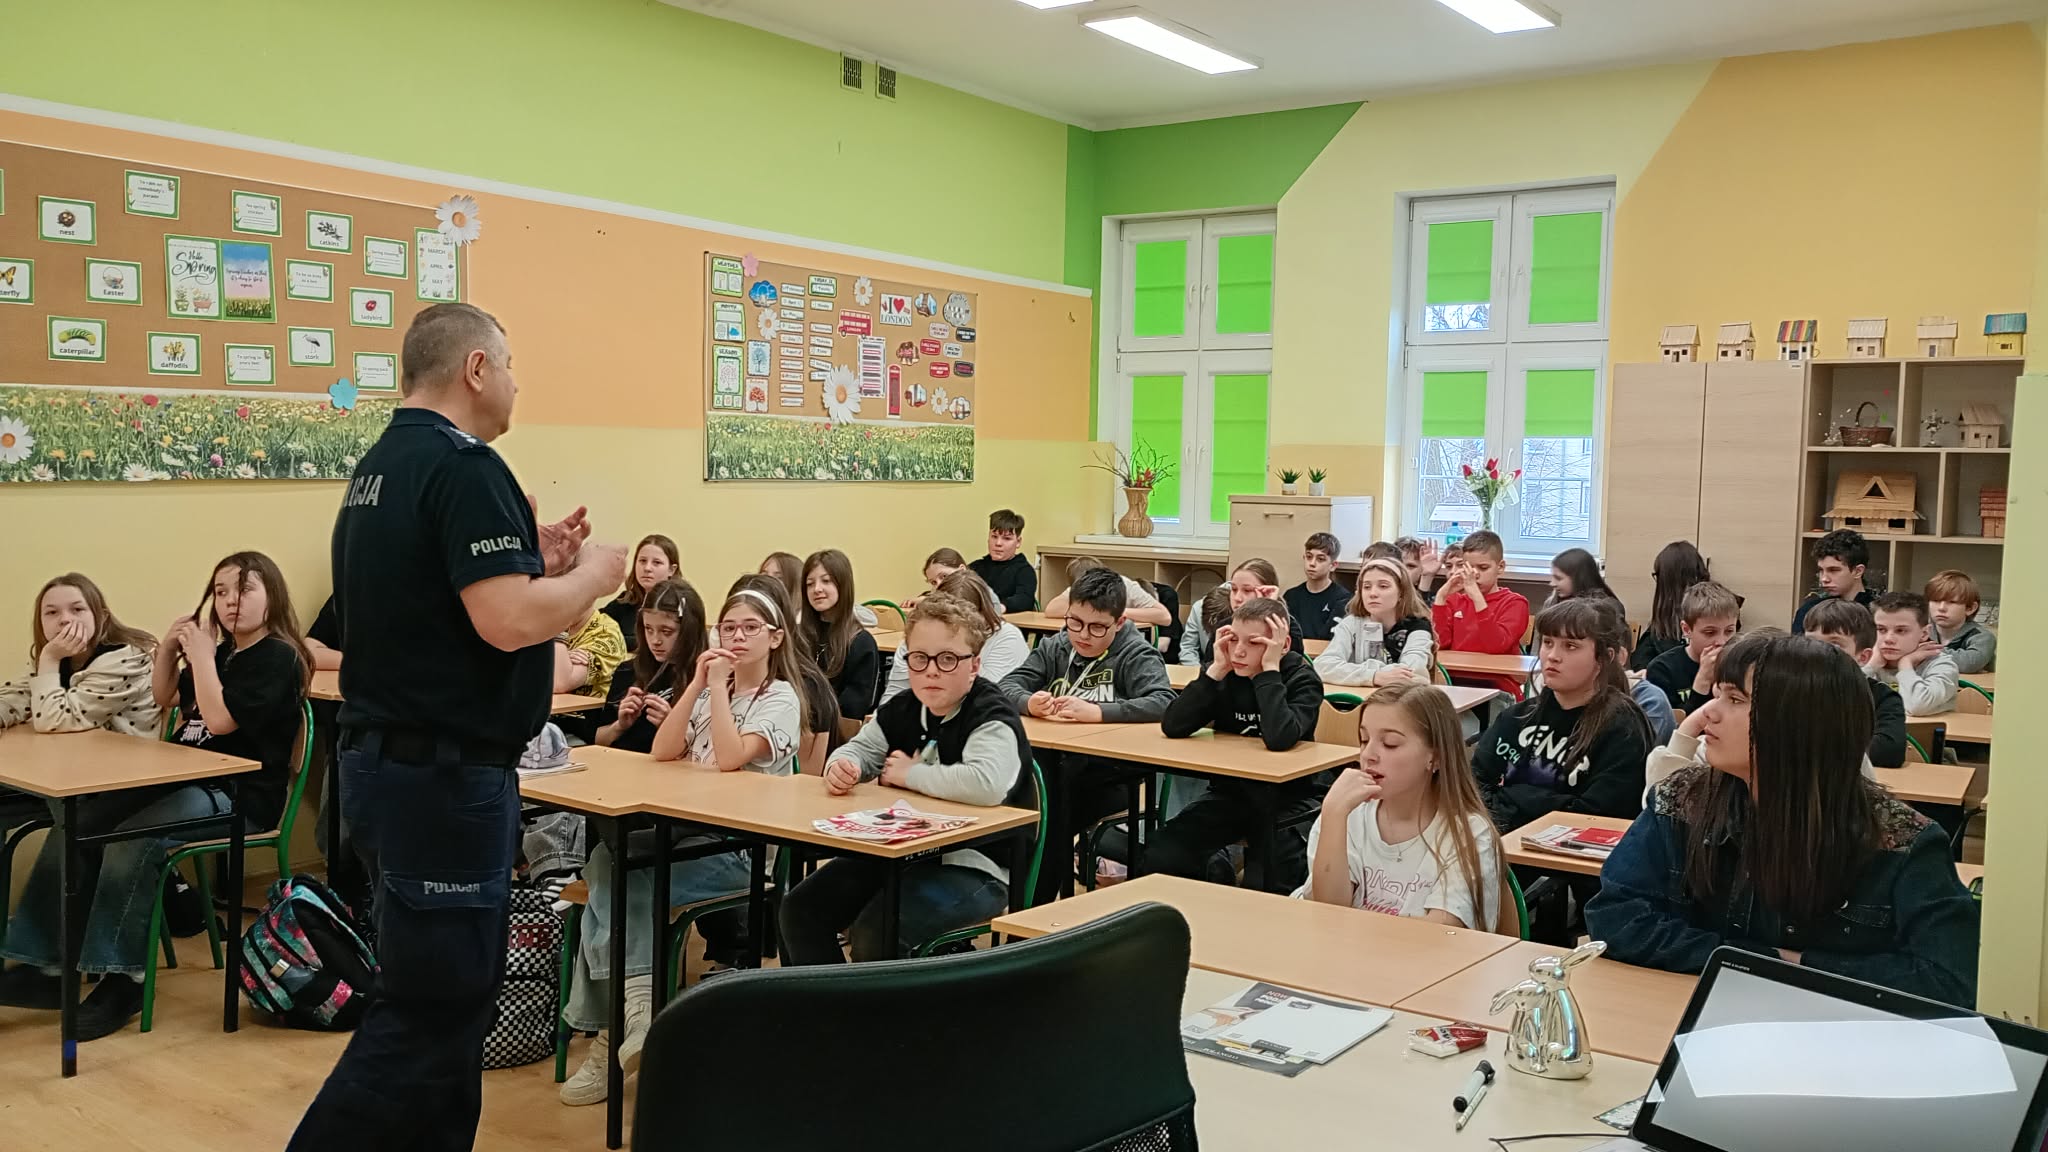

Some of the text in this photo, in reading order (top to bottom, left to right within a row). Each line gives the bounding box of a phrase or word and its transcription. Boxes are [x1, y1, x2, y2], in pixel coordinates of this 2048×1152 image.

[319, 239, 340, 247] catkins
[172, 252, 217, 286] Spring
[103, 289, 125, 297] Easter
[887, 297, 893, 314] I
[880, 314, 911, 325] LONDON
[59, 347, 95, 356] caterpillar
[161, 362, 188, 370] daffodils
[470, 535, 523, 557] POLICJA
